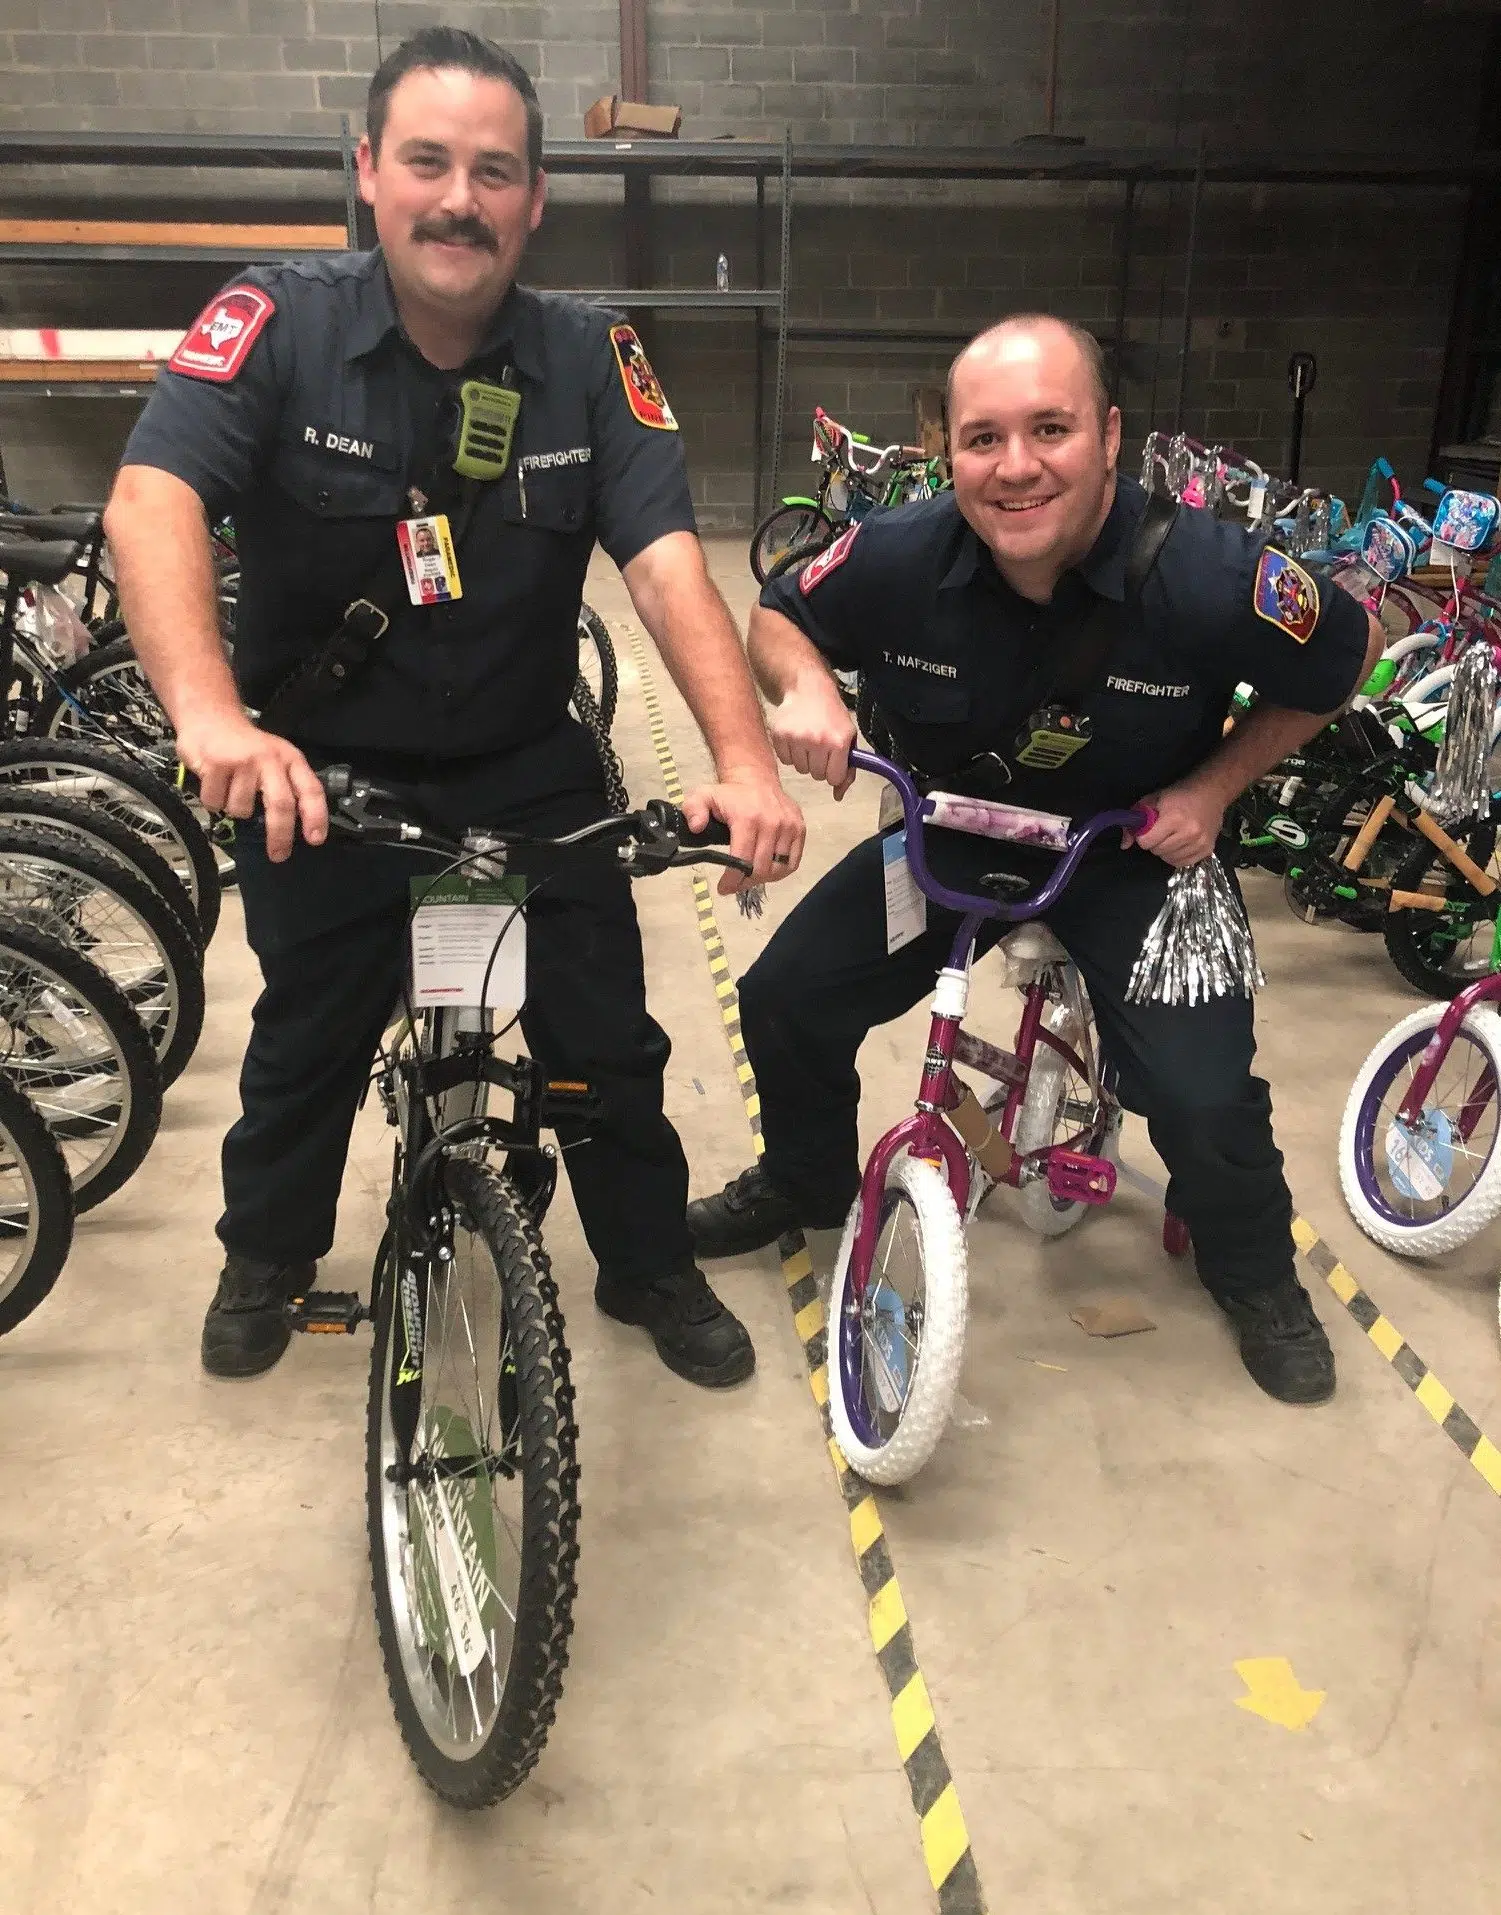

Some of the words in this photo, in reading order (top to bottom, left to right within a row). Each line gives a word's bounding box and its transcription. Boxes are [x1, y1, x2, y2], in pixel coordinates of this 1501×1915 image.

[209, 320, 238, 334] EMT
[304, 426, 319, 445] R.
[326, 433, 374, 459] DEAN
[522, 447, 592, 471] FIREFIGHTER
[882, 650, 893, 664] T.
[897, 654, 957, 679] NAFZIGER
[1106, 675, 1190, 698] FIREFIGHTER
[430, 1421, 491, 1614] MUNTAIN
